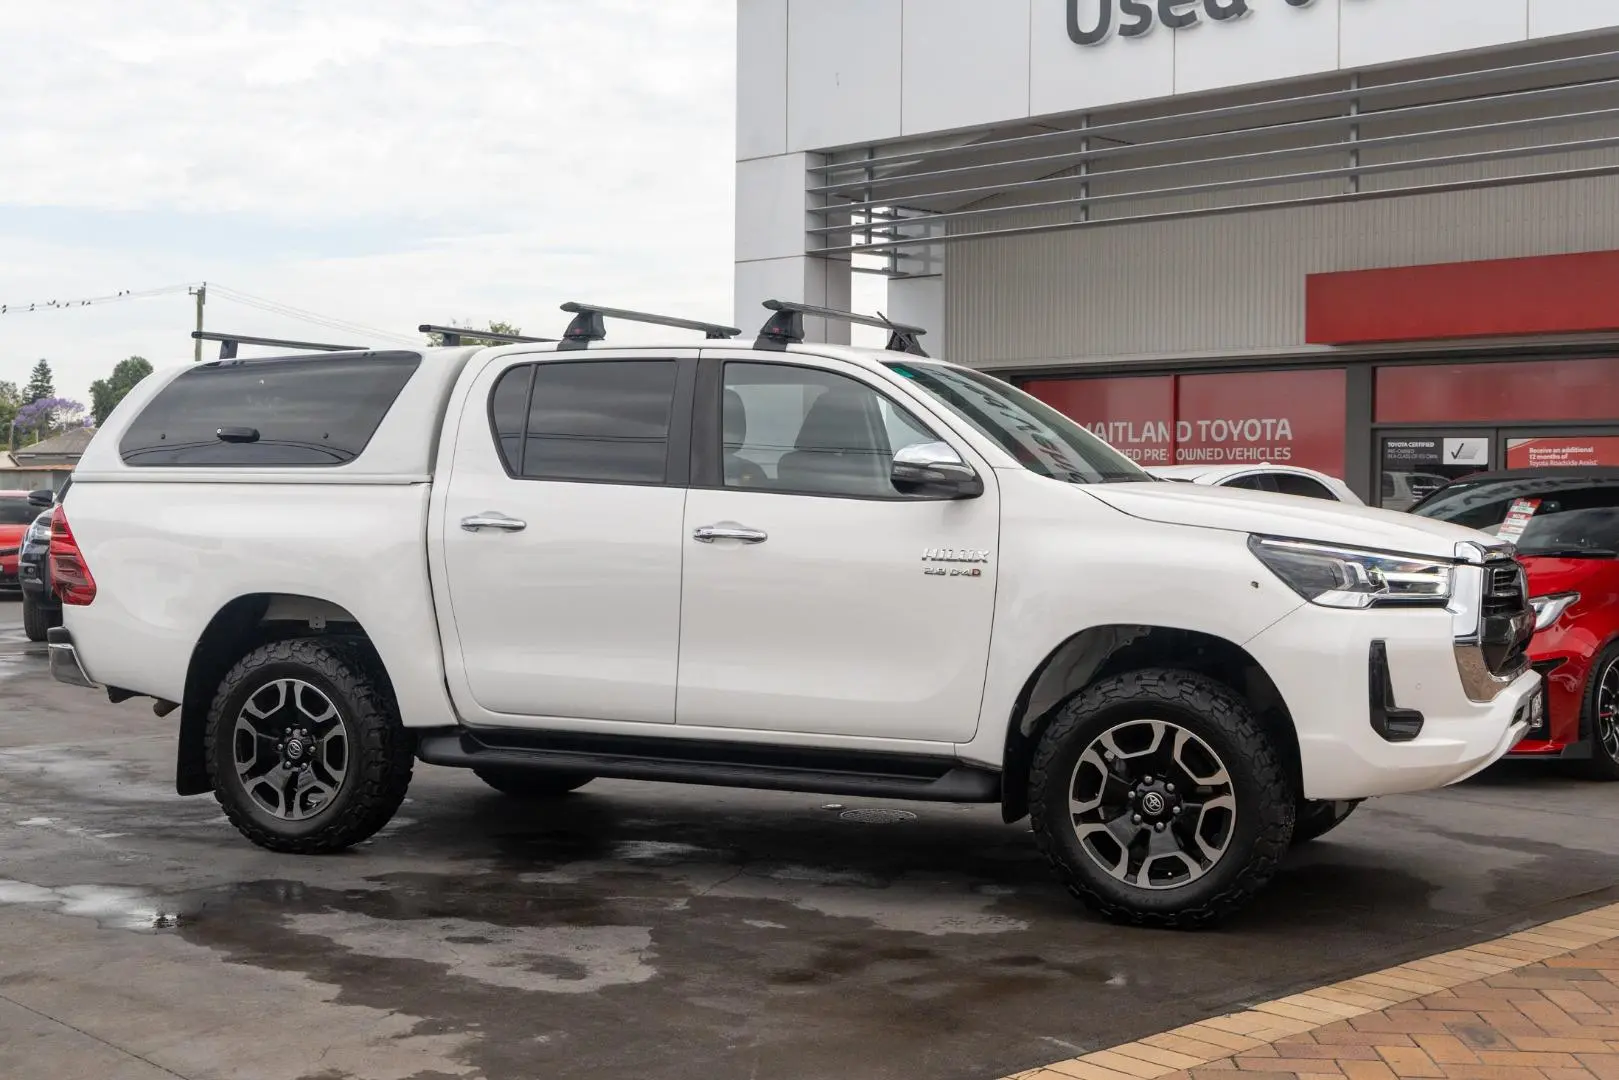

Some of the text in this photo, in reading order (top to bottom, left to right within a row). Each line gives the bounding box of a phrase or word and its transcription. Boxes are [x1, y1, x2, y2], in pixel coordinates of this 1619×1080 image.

[1197, 418, 1293, 441] TOYOTA
[1226, 447, 1291, 460] VEHICLES
[921, 548, 989, 563] HILUX
